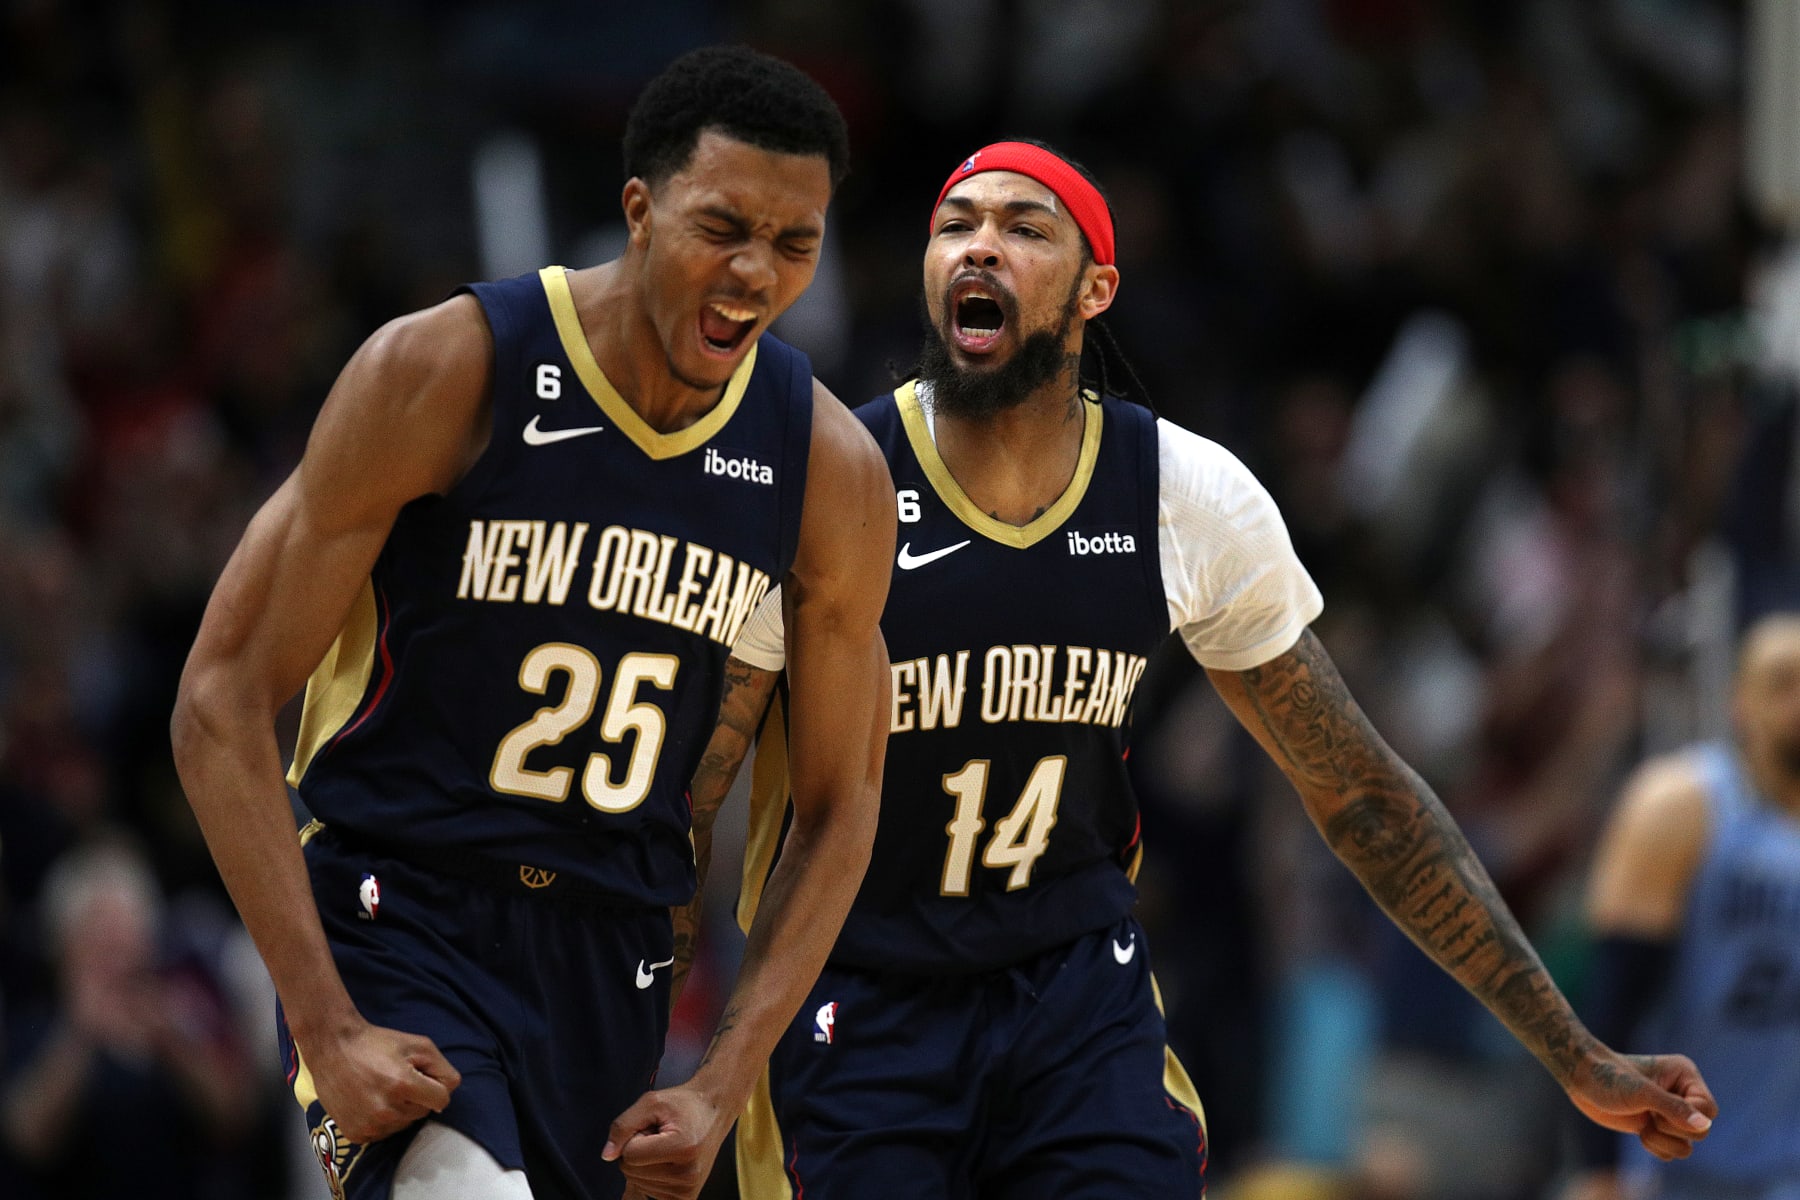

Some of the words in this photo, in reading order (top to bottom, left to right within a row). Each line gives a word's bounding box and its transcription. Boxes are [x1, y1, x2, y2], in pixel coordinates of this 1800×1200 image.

[536, 364, 561, 400] 6
[704, 448, 774, 485] ibotta
[896, 489, 921, 523] 6
[456, 520, 590, 605] NEW
[1067, 531, 1136, 555] ibotta
[890, 650, 970, 734] EW
[489, 642, 680, 813] 25
[939, 755, 1068, 897] 14
